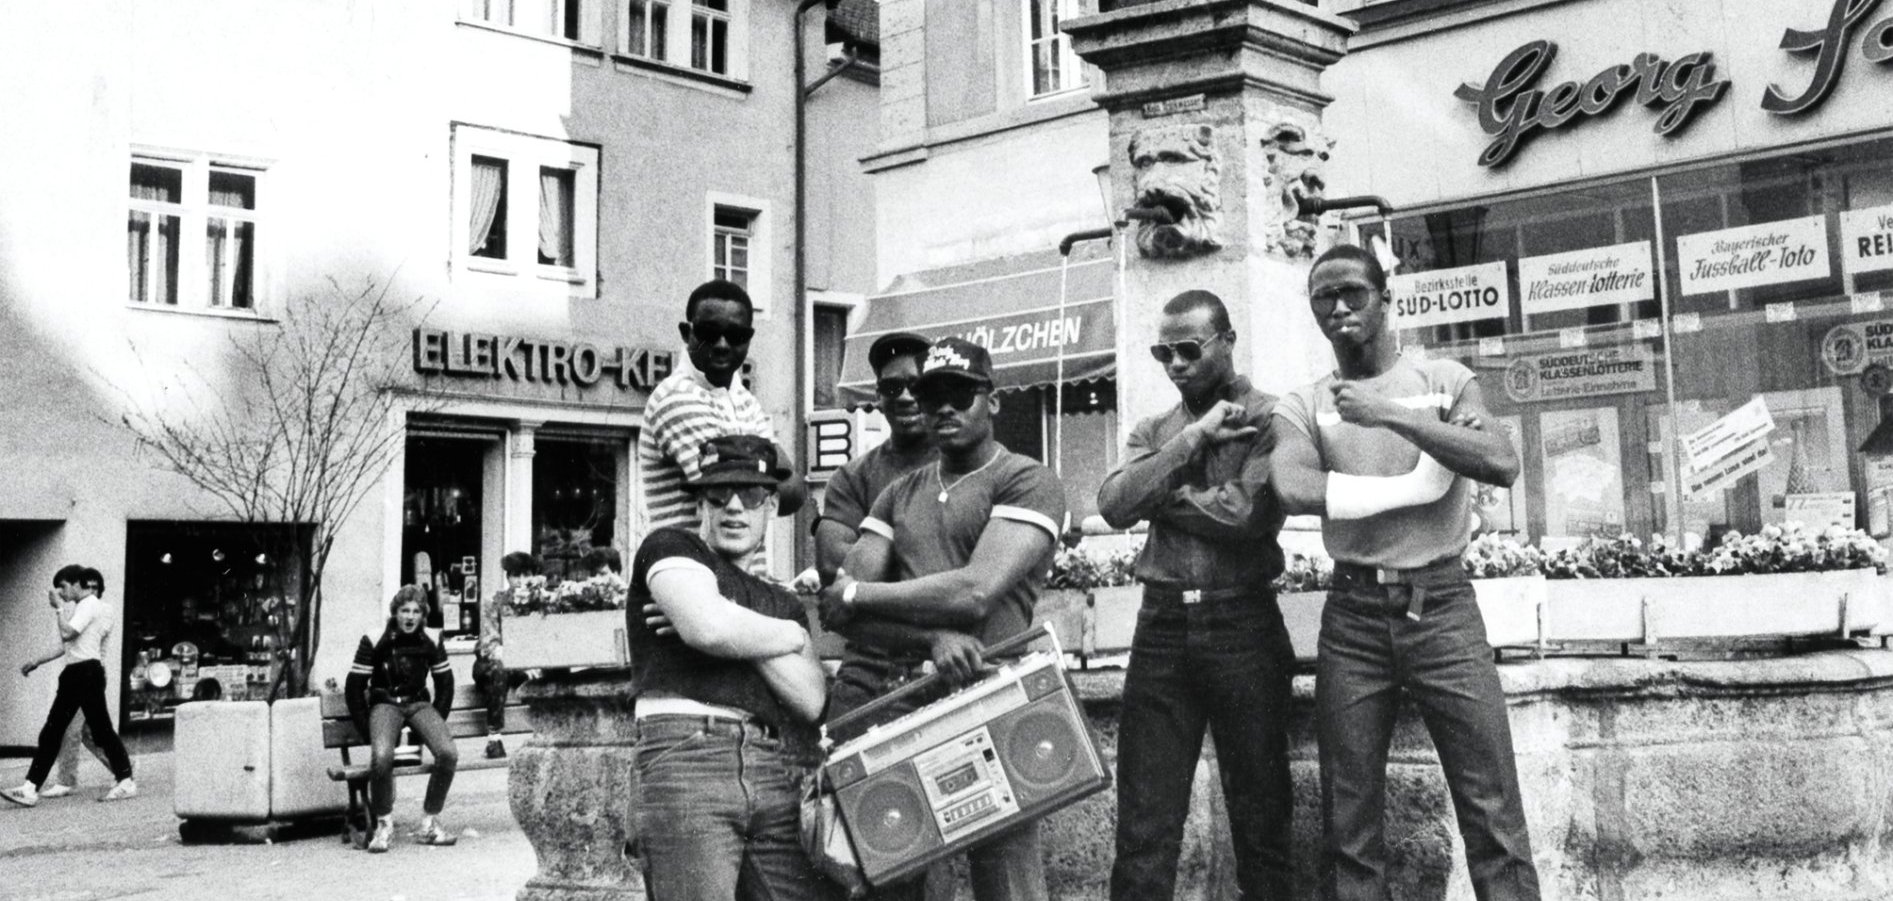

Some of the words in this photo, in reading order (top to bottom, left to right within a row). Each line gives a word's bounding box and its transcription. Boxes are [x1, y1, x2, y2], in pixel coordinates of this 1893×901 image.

[1453, 39, 1732, 168] Georg
[1415, 274, 1478, 294] Bezirksstelle
[957, 315, 1082, 355] ÖLZCHEN
